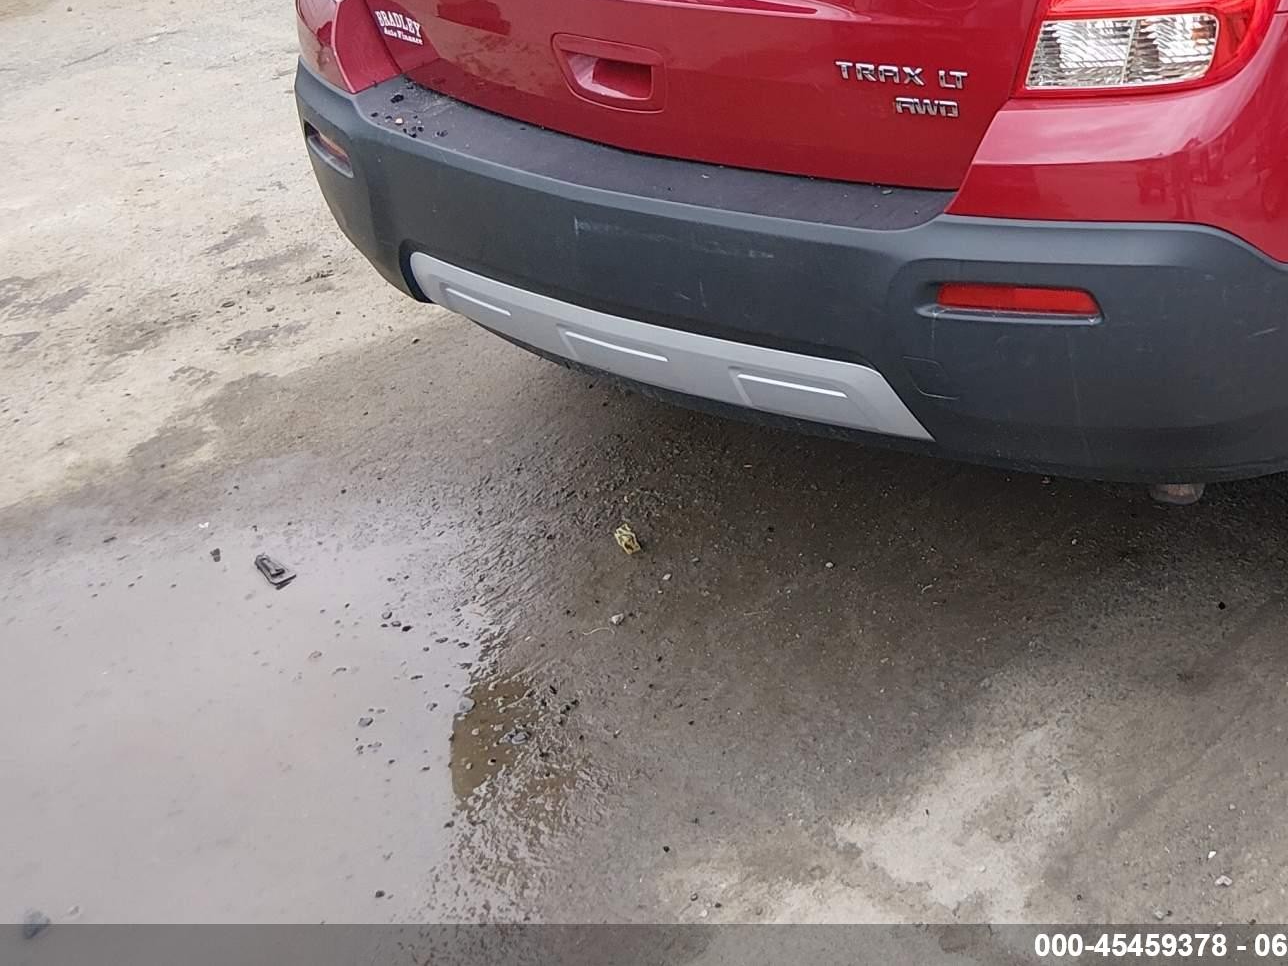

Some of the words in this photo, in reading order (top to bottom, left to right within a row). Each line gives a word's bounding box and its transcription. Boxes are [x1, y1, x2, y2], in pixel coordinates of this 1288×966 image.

[374, 10, 422, 38] BRADLEY
[835, 60, 925, 86] TRAX
[938, 70, 968, 90] LT
[894, 96, 960, 118] AWD
